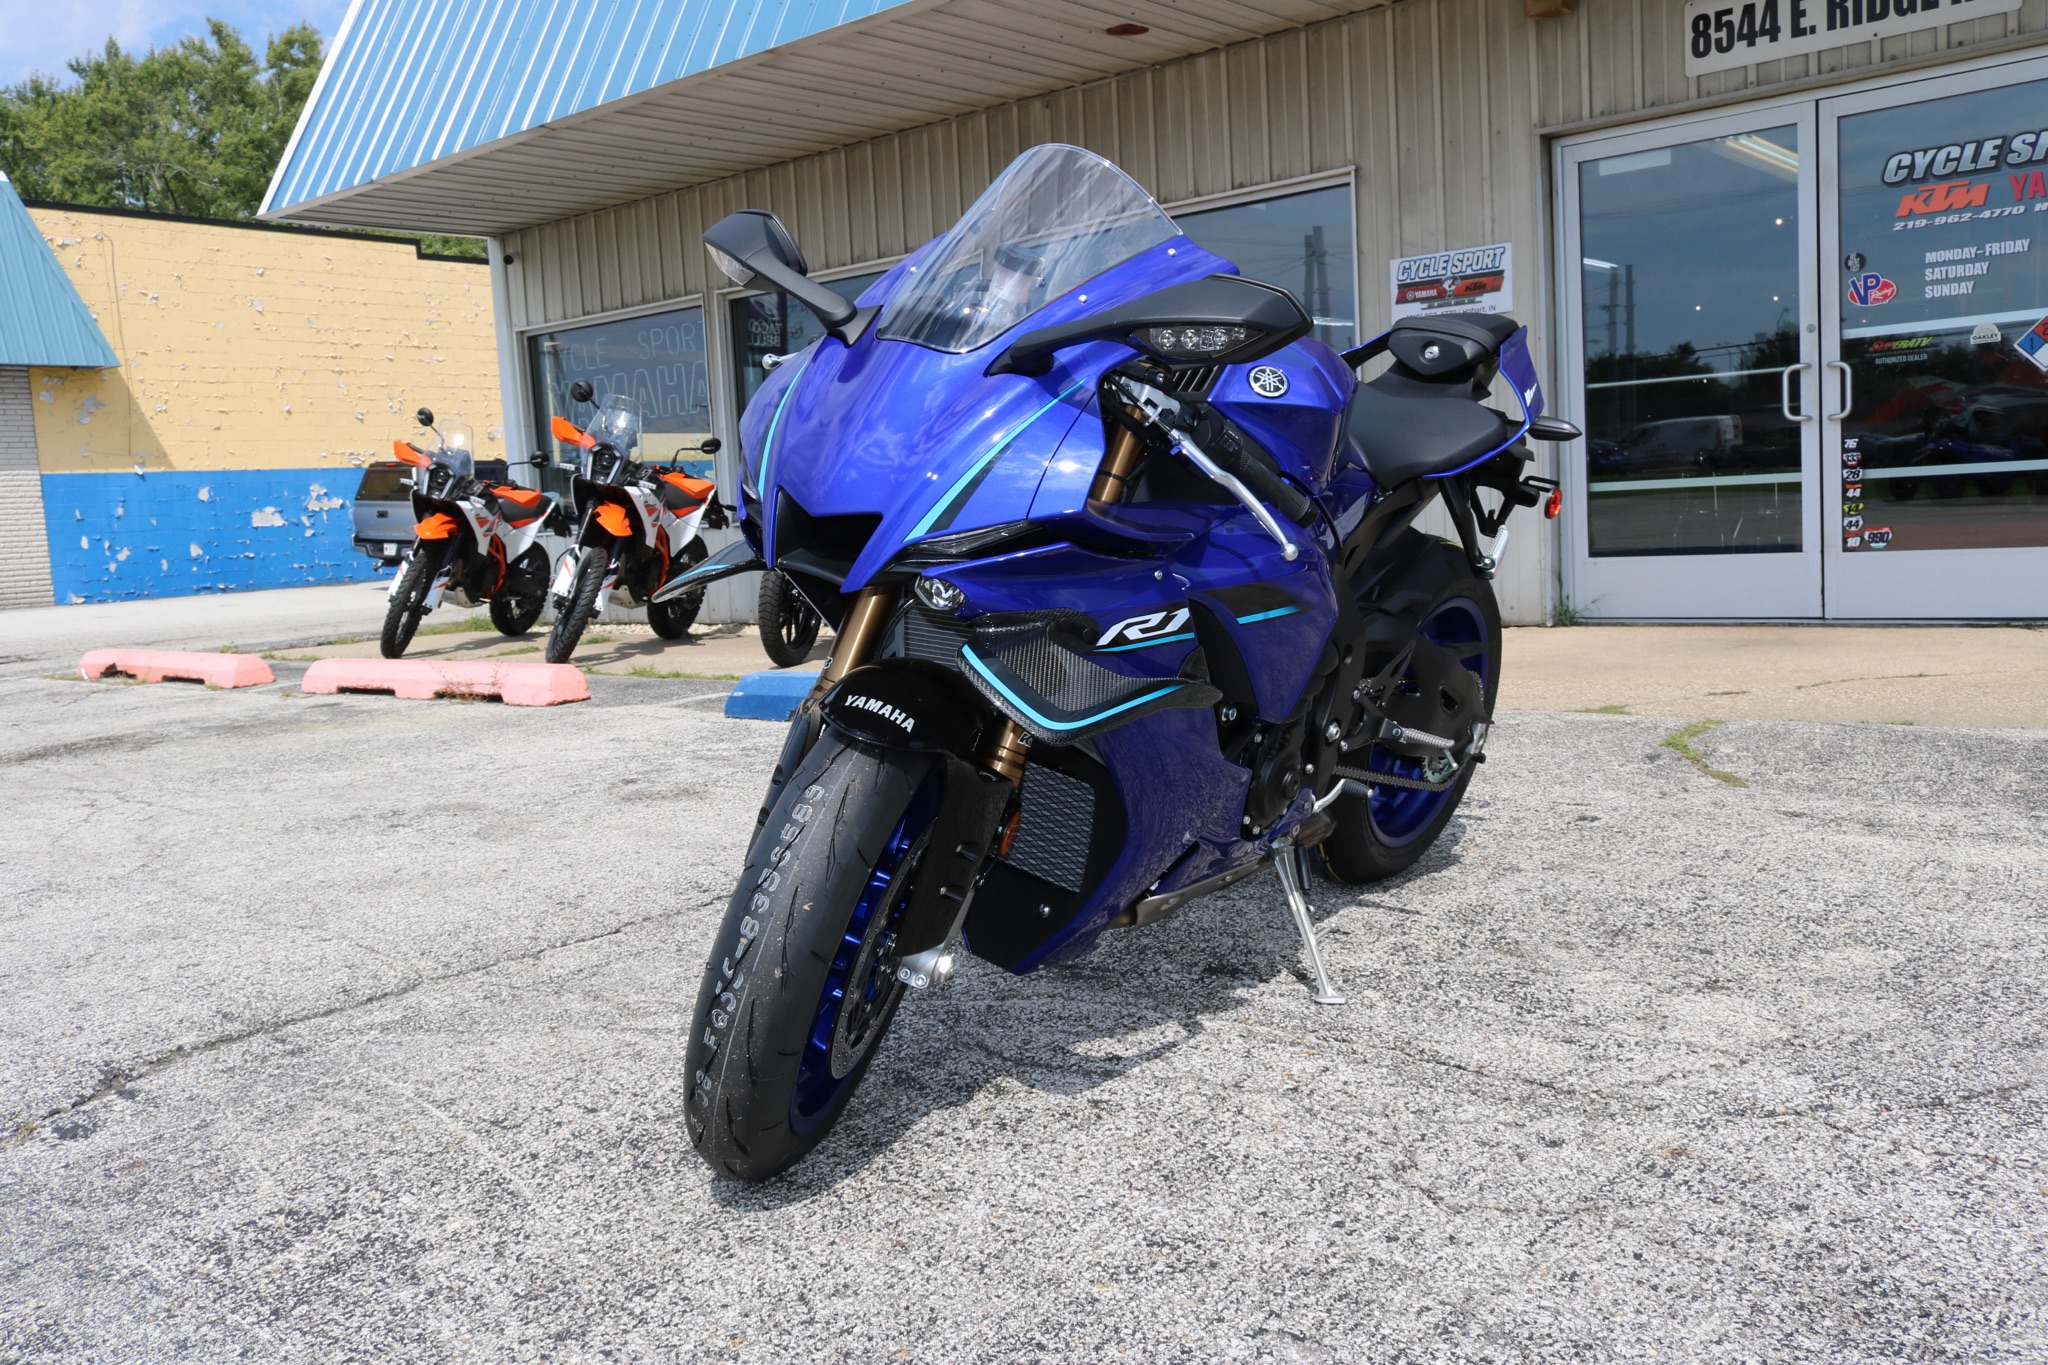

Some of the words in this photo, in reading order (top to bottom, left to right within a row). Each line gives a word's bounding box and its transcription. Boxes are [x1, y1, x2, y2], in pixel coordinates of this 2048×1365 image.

[1691, 0, 1781, 59] 8544
[1791, 0, 1817, 39] E.
[1827, 0, 1939, 32] RID
[1882, 136, 2005, 187] CYCLE
[1895, 179, 1990, 218] KTM
[1893, 205, 2026, 231] 219-962-4770
[1397, 254, 1450, 282] CYCLE
[1451, 246, 1505, 275] SPORT
[1925, 262, 1989, 281] SATURDAY
[1415, 289, 1437, 299] YAMAHA
[1849, 272, 1882, 306] VP
[1925, 281, 1974, 298] SUNDAY
[638, 321, 704, 360] SPOR
[1972, 333, 1999, 341] OAKLEY
[1875, 355, 1907, 365] AUTHORIZED
[1907, 353, 1928, 362] DEALER
[1844, 438, 1859, 448] 76
[1846, 488, 1861, 498] 44
[1845, 519, 1860, 530] 44
[1846, 536, 1861, 547] 10
[1867, 531, 1890, 543] 990
[1097, 607, 1191, 647] R1
[844, 694, 916, 734] YAMAHA
